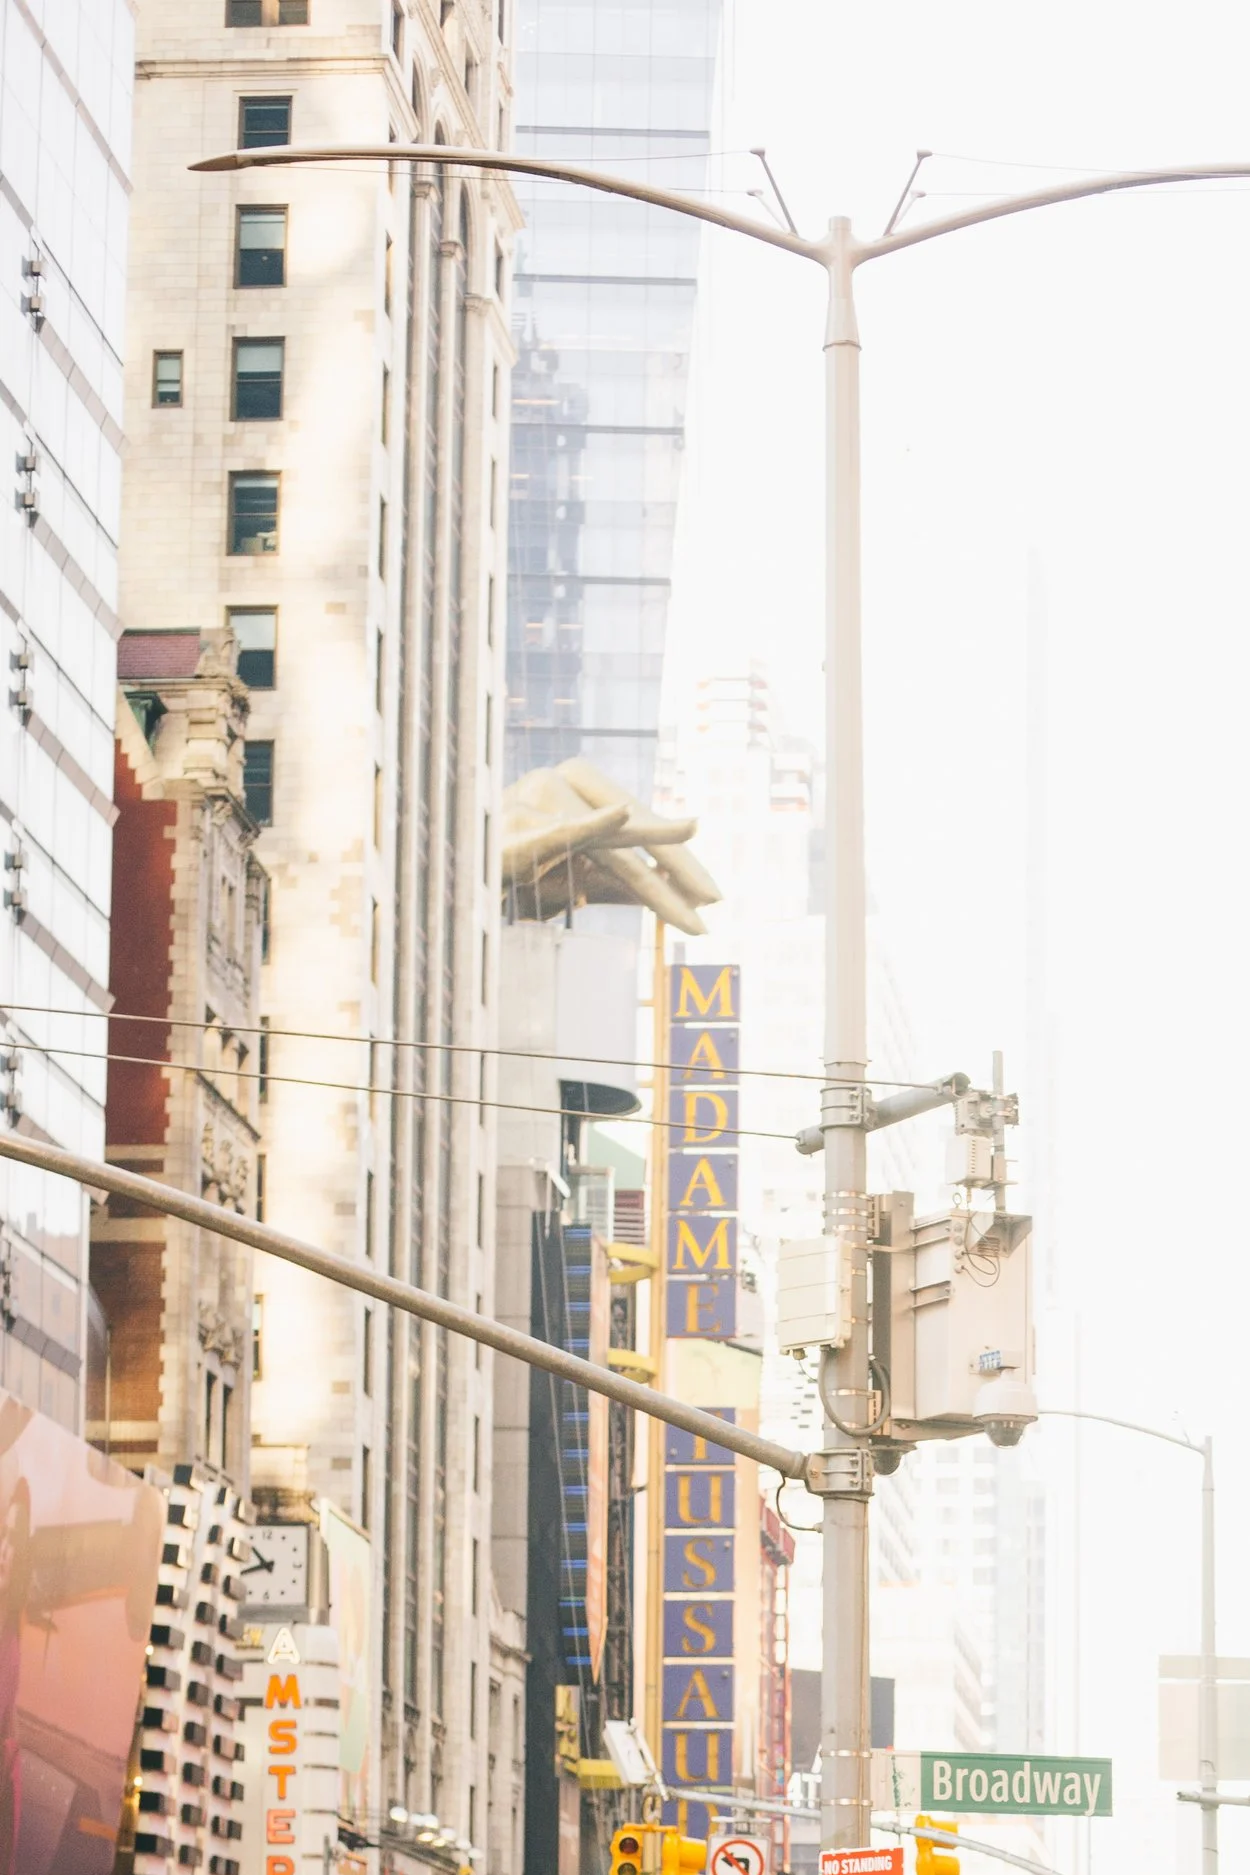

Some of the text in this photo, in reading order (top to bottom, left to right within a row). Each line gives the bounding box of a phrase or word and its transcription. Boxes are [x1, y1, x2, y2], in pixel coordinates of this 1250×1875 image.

[674, 966, 735, 1334] MADAME
[932, 1759, 1102, 1817] Broadway
[840, 1854, 893, 1875] STANDING
